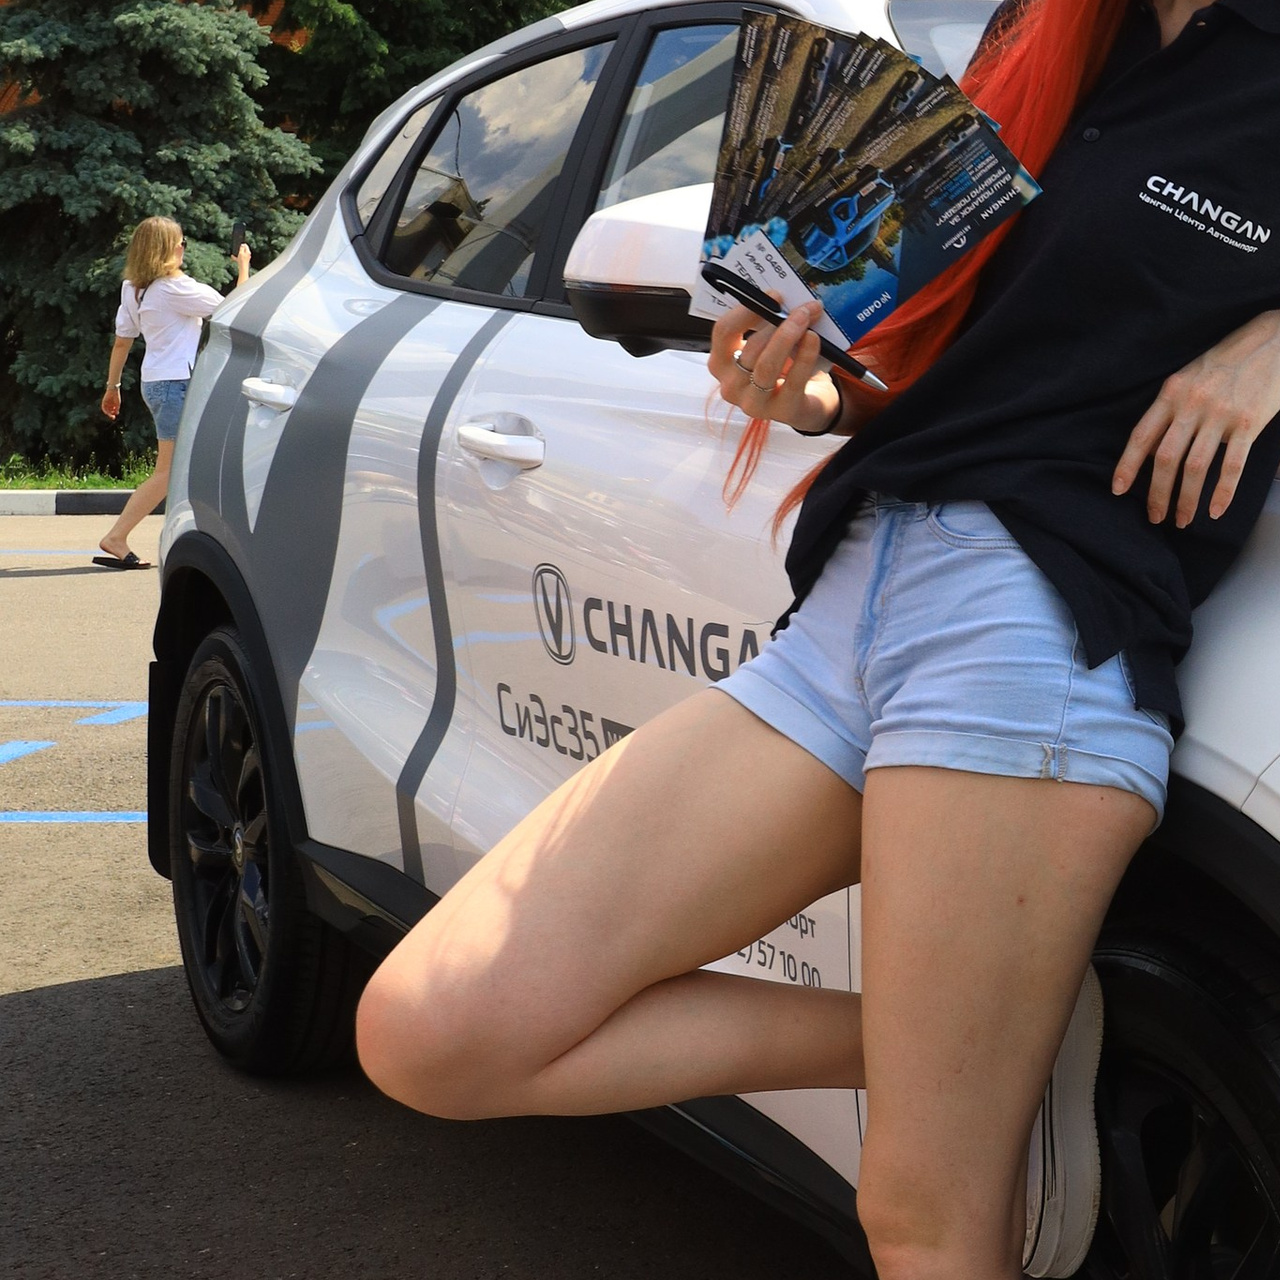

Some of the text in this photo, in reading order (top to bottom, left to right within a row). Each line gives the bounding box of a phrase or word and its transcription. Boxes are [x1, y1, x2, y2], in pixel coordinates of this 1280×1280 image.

[993, 173, 1012, 191] ВАШ
[960, 188, 995, 218] ПОДАРОК
[980, 185, 1020, 220] CHANGAN
[1146, 175, 1271, 244] CHANGAN
[1138, 191, 1259, 254] Чанган Центр Автоимпорт
[735, 260, 760, 289] ТЕЛЕ
[745, 251, 765, 274] ИМЯ
[765, 253, 788, 280] 0488
[584, 597, 759, 682] CHANGA
[497, 682, 600, 762] СиЭс35
[757, 940, 775, 970] 57
[780, 951, 798, 982] 10
[802, 961, 822, 988] 00
